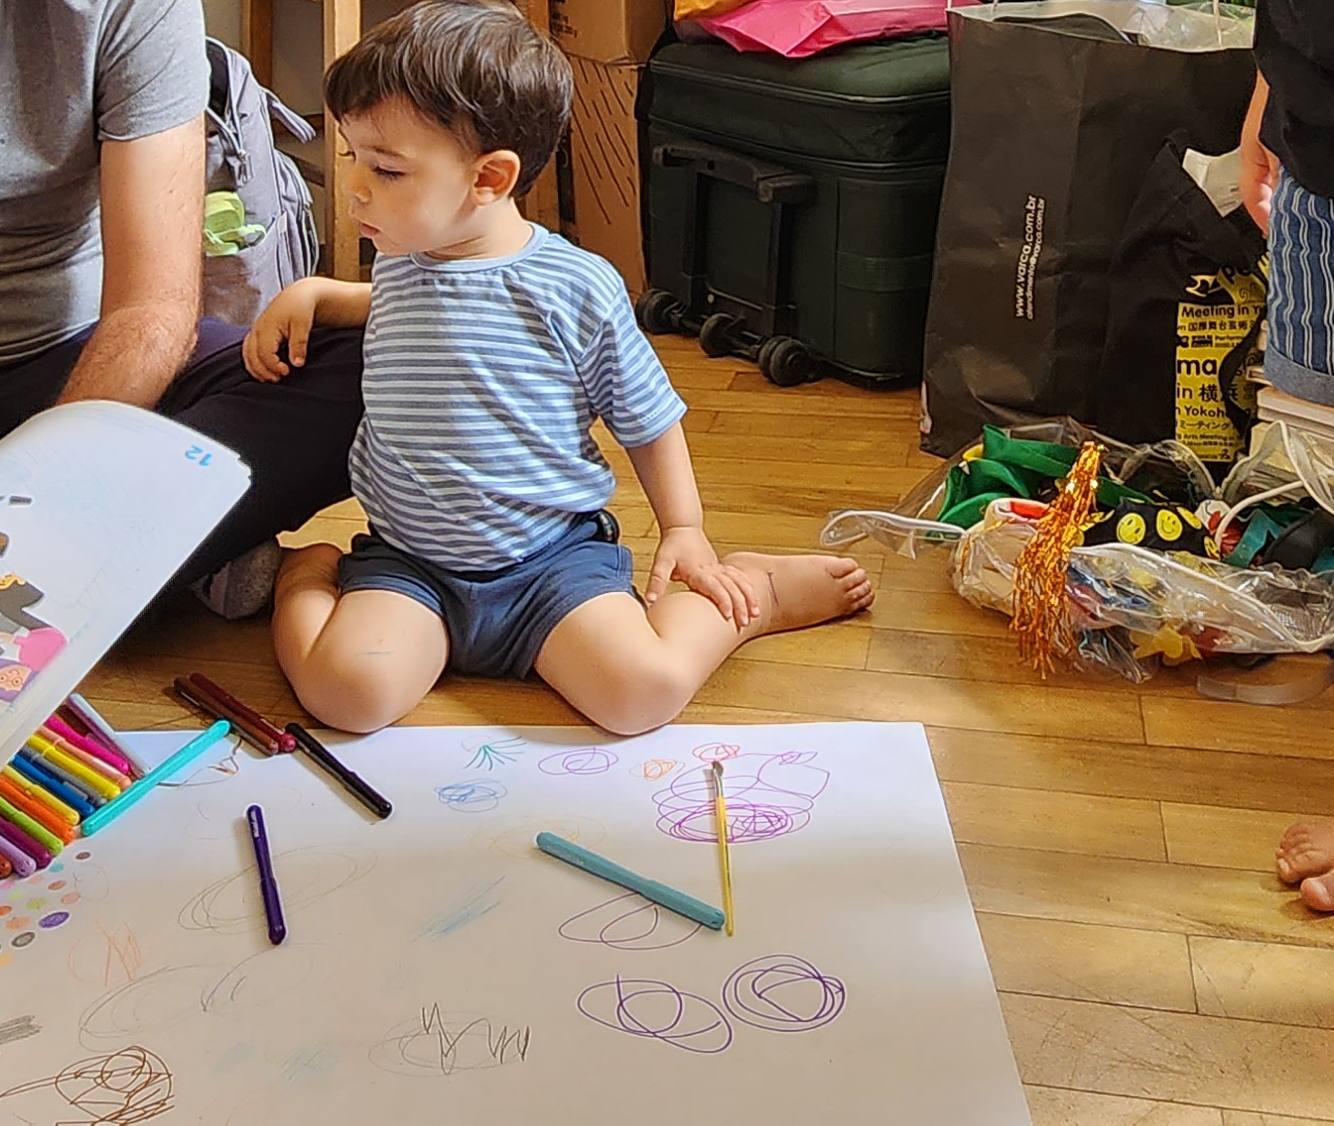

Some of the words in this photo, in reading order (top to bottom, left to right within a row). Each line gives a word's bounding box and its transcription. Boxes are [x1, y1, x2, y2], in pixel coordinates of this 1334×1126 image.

[1016, 195, 1036, 317] www.varca.com.br
[1181, 305, 1233, 319] Meeting
[184, 444, 212, 467] 12
